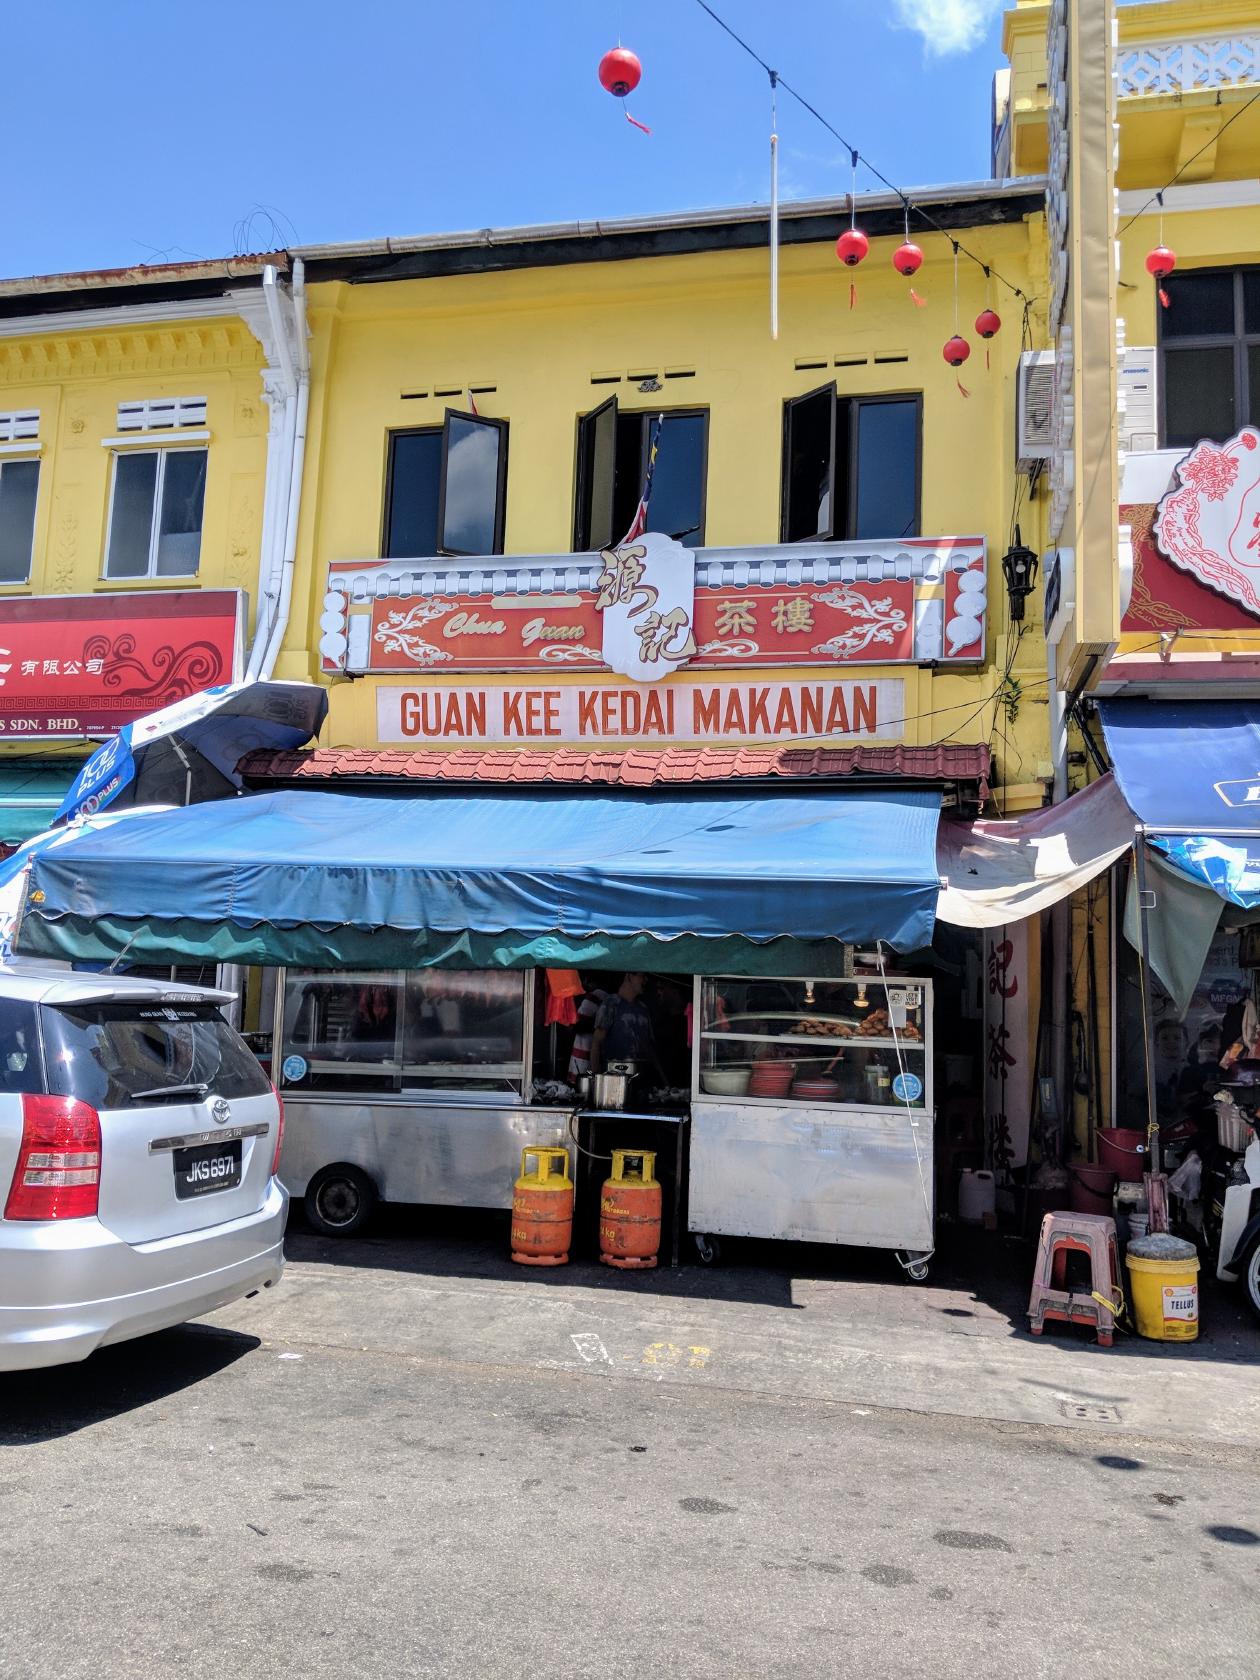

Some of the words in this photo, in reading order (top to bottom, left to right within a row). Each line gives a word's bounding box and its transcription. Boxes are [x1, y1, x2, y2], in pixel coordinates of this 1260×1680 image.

[715, 599, 815, 635] 茶樓
[21, 659, 104, 676] 有限公司
[400, 692, 487, 737] GUAN
[503, 691, 561, 737] KEE
[578, 689, 675, 736] KEDAI
[693, 685, 878, 735] MAKANAN
[10, 719, 42, 731] SDN.
[47, 719, 82, 731] BHD.
[1171, 1299, 1194, 1310] TELLUS
